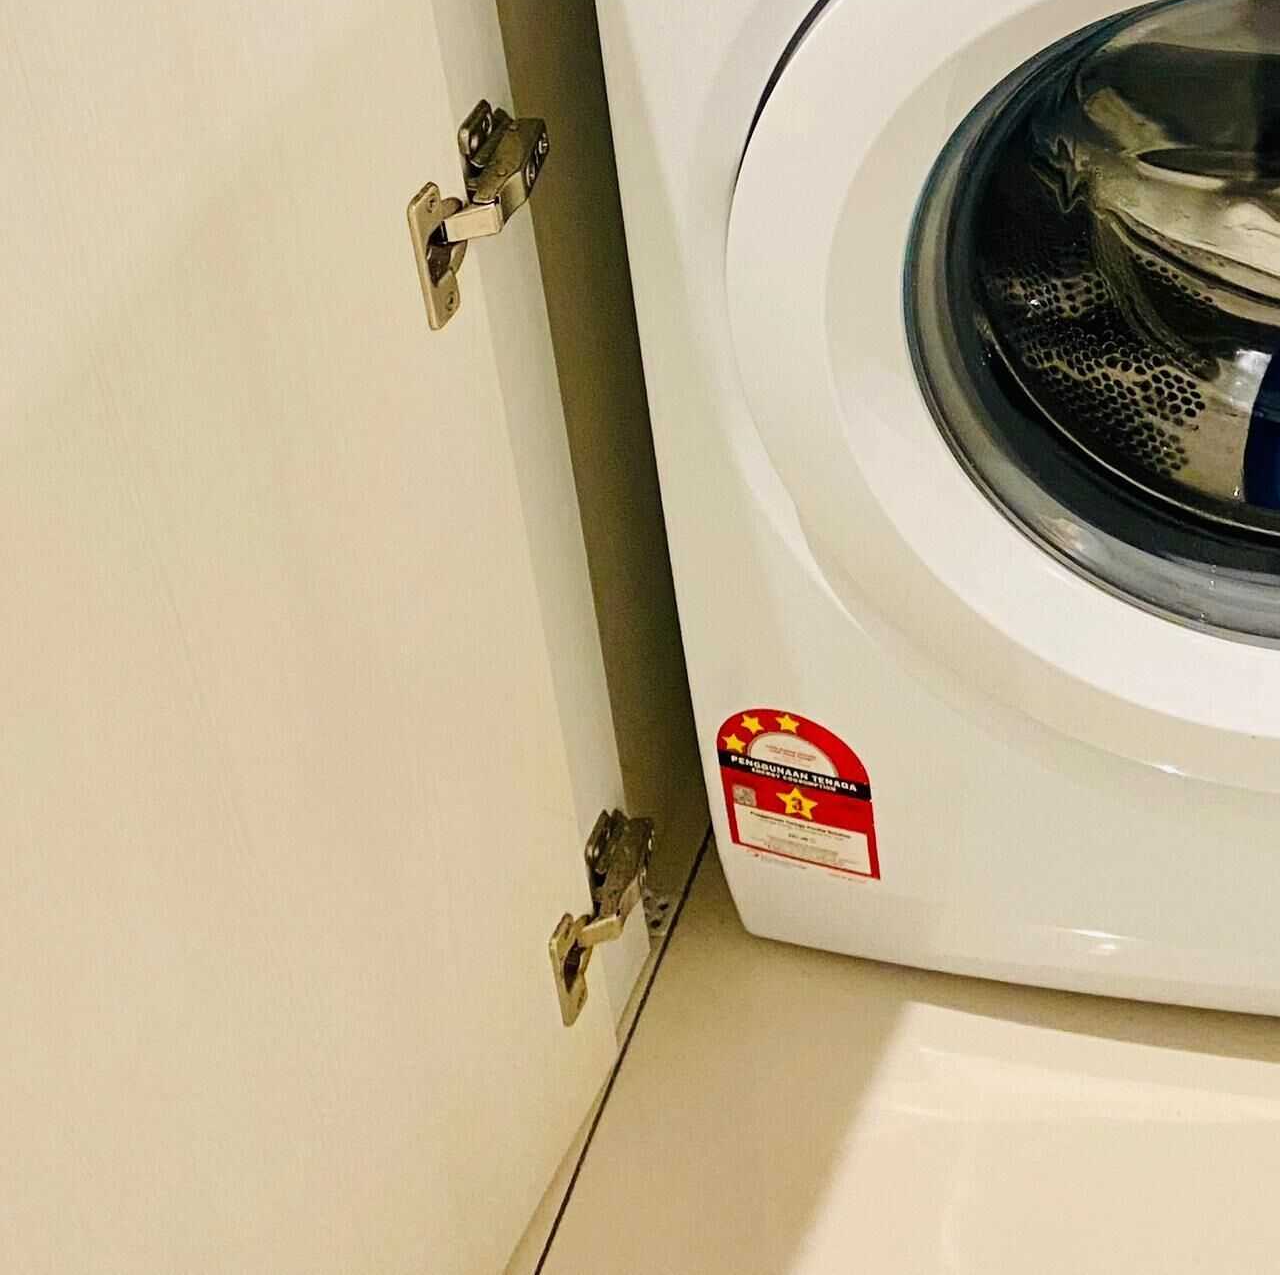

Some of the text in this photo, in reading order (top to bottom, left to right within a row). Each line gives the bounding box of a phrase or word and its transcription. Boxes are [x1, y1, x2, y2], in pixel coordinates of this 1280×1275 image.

[730, 755, 809, 781] PENGGUNAAN
[811, 774, 858, 793] TENAGA
[790, 796, 804, 812] 3
